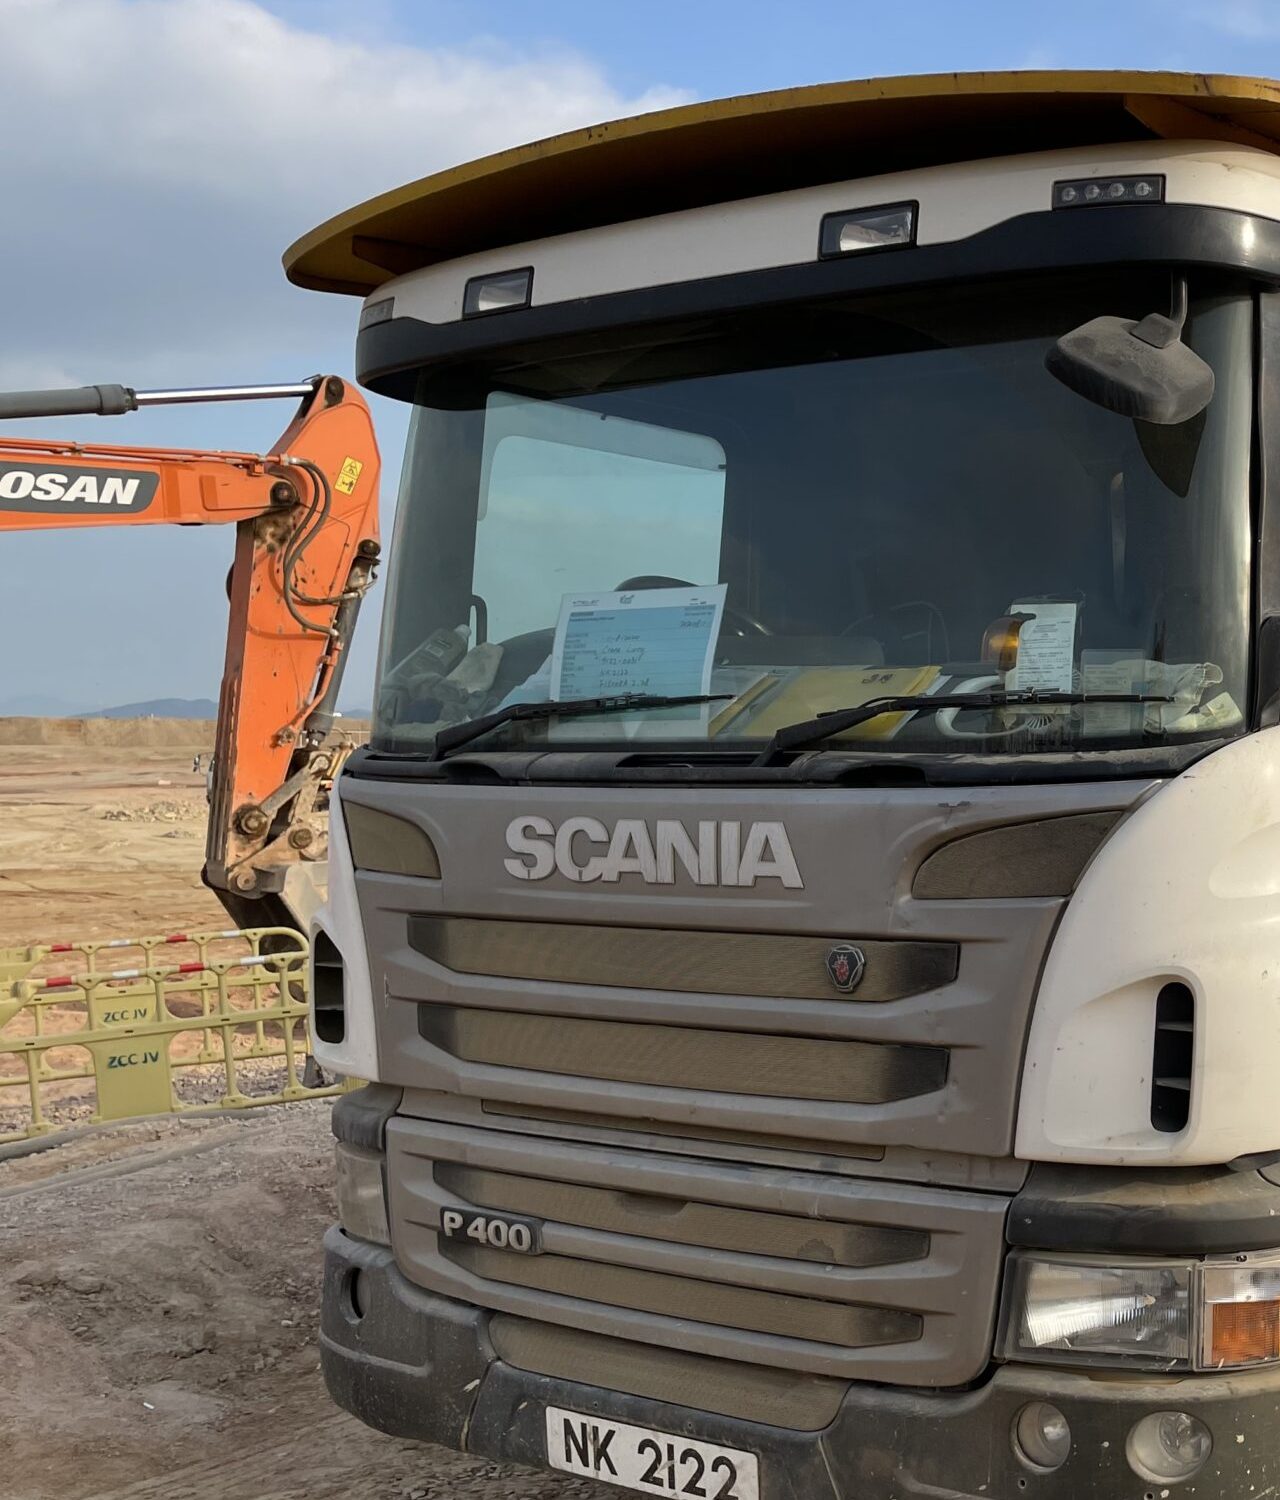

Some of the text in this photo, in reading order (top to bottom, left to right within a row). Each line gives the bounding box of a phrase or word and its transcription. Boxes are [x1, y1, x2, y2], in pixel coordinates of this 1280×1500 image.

[0, 471, 140, 505] OSAN
[504, 815, 805, 889] SCANIA
[103, 1008, 147, 1023] ZCC JV
[108, 1051, 159, 1069] ZCC JV
[443, 1210, 532, 1252] P 400
[563, 1418, 739, 1500] NK 2122
